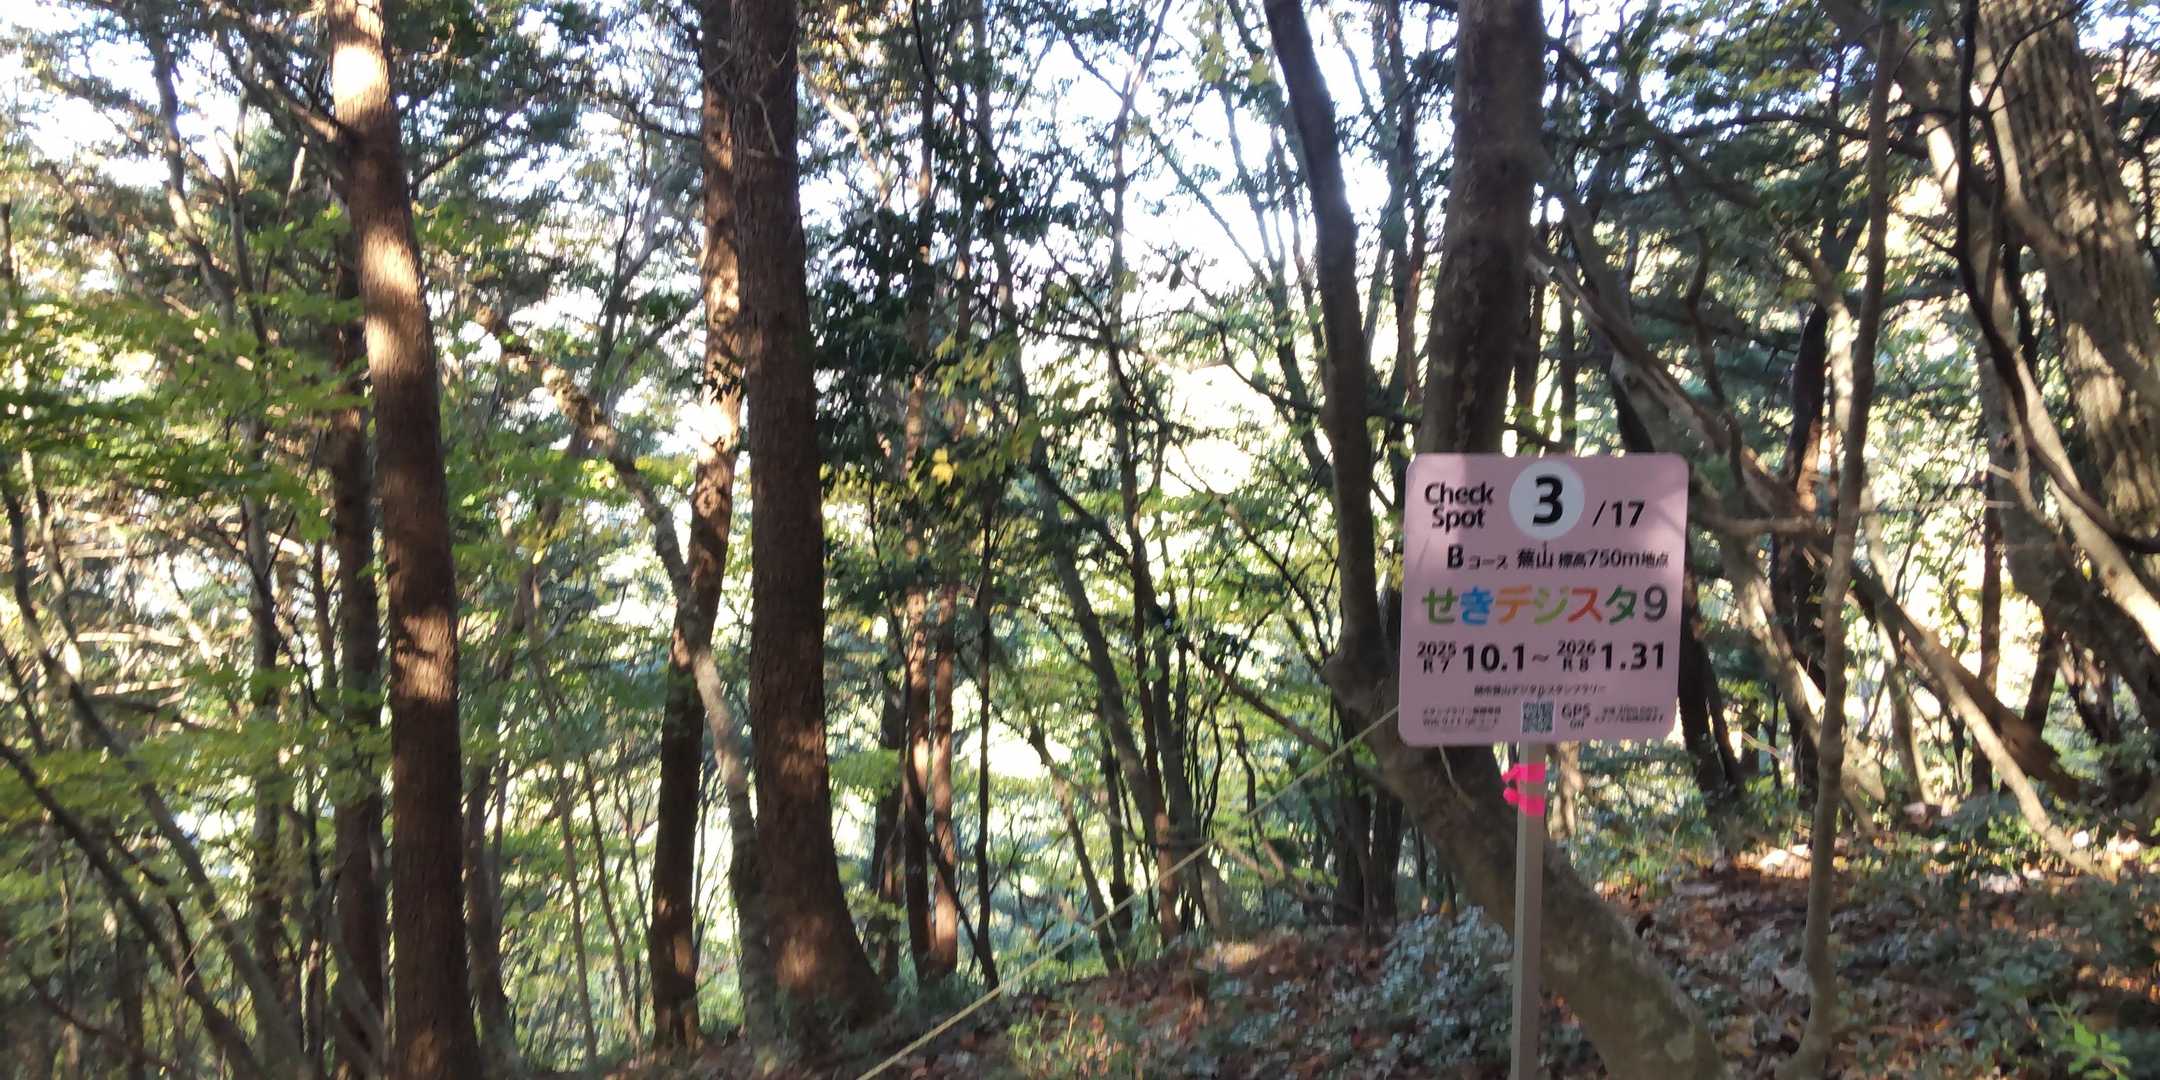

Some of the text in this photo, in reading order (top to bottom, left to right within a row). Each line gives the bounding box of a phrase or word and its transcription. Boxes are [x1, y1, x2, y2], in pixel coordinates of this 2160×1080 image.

[1424, 482, 1494, 506] Check
[1532, 475, 1564, 527] 3
[1432, 507, 1485, 534] Spot
[1421, 584, 1669, 625] せきデジスタ9
[1417, 640, 1457, 657] 2025
[1556, 639, 1597, 656] 2026
[1601, 642, 1665, 671] 1.31
[1561, 702, 1591, 720] GPS
